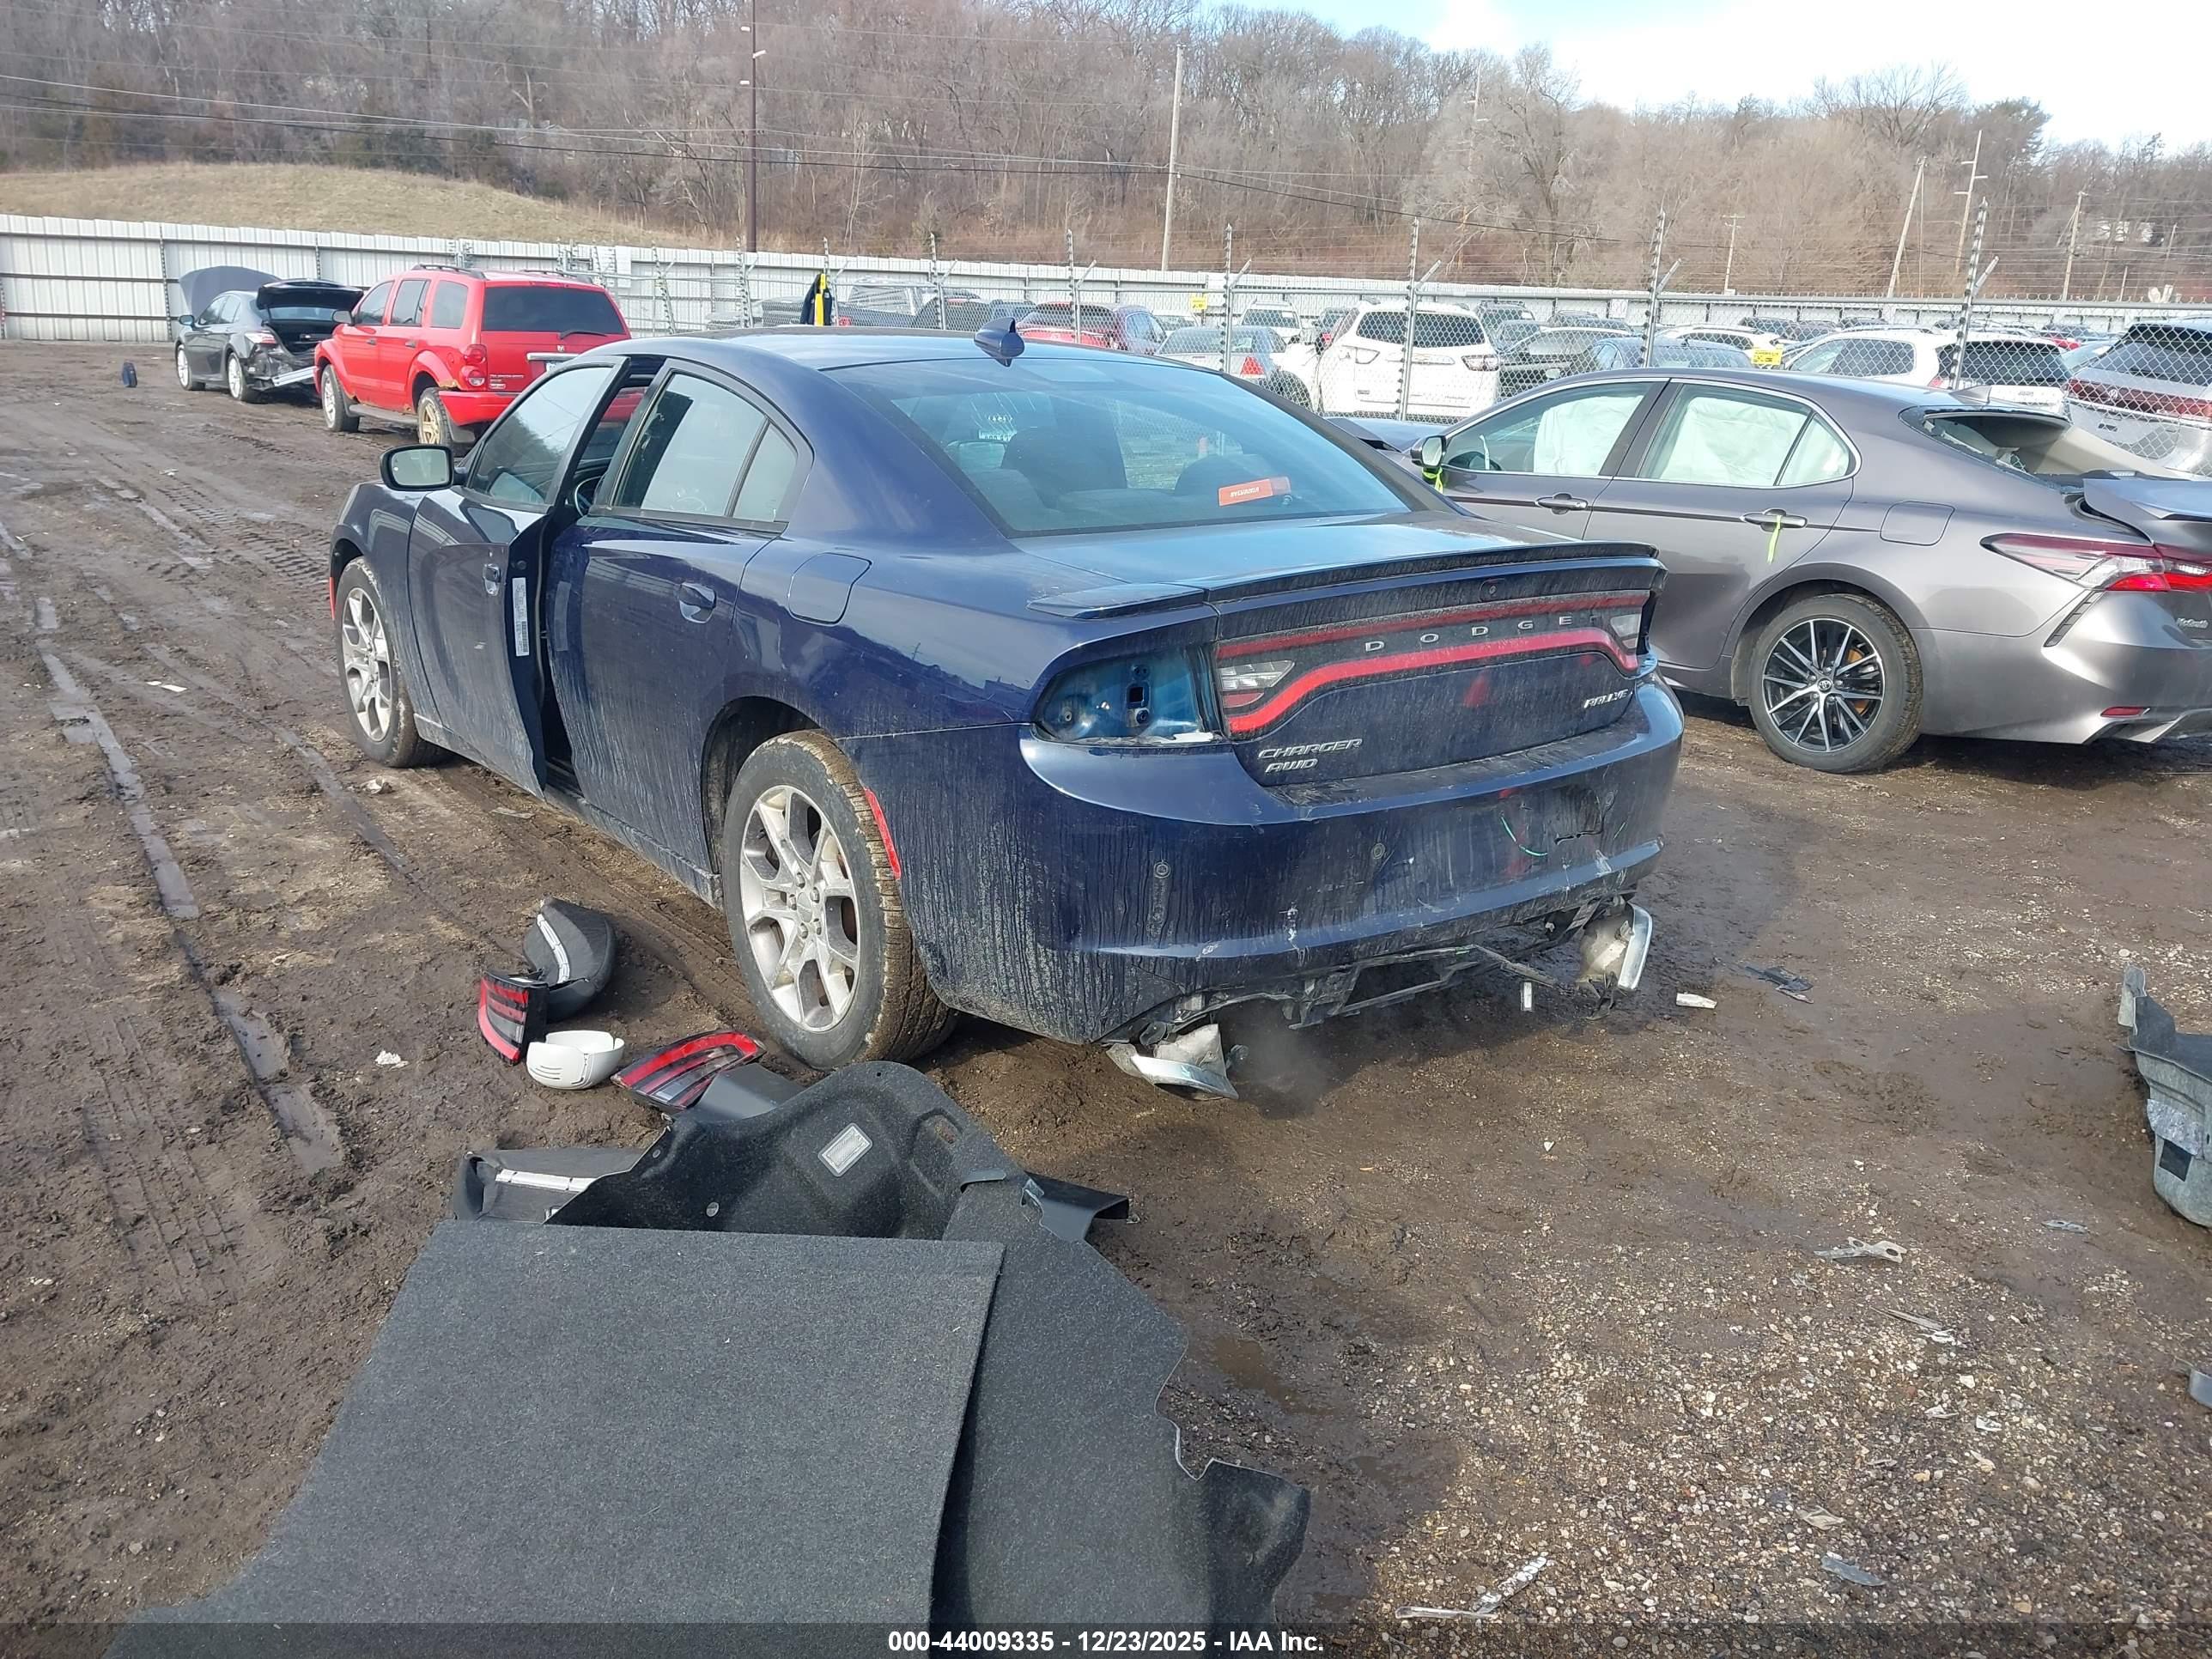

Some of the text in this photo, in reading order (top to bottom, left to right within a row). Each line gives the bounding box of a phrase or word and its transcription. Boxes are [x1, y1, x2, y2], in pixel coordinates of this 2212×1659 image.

[1365, 616, 1573, 652] DODGE
[1258, 738, 1363, 759] CHARGER
[1265, 758, 1318, 774] AWD
